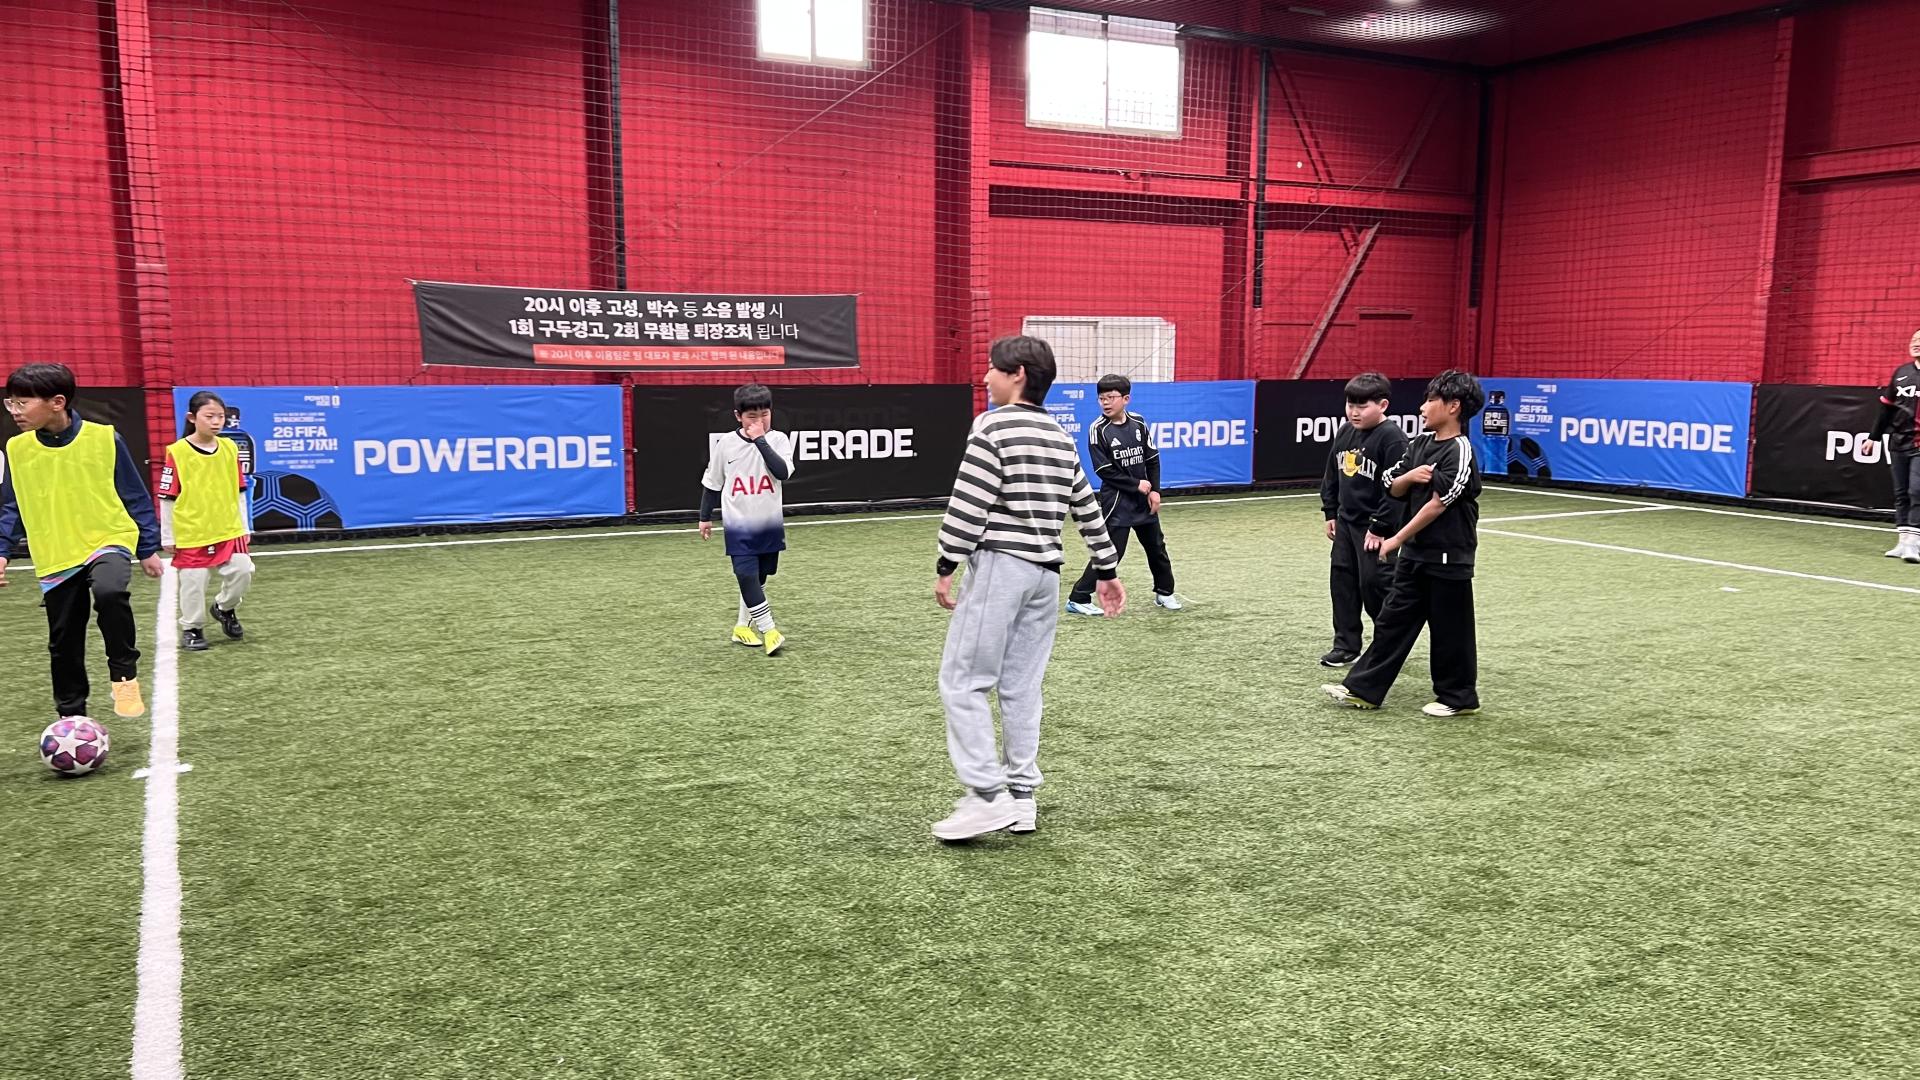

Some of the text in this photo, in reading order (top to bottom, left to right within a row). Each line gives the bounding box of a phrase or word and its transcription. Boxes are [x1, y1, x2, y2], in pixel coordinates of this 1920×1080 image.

[523, 297, 783, 319] 20시 이후 고성, 박수 등 소음 발생 시
[509, 319, 799, 340] 1회 구두경고, 2회 무환불 퇴장조치 됩니다
[551, 350, 572, 360] 20시
[273, 426, 327, 438] 26 FIFA
[1150, 419, 1246, 449] ERADE
[1560, 417, 1733, 453] POWERADE
[306, 438, 338, 451] 가자!
[353, 435, 612, 475] POWERADE
[731, 474, 775, 497] AIA
